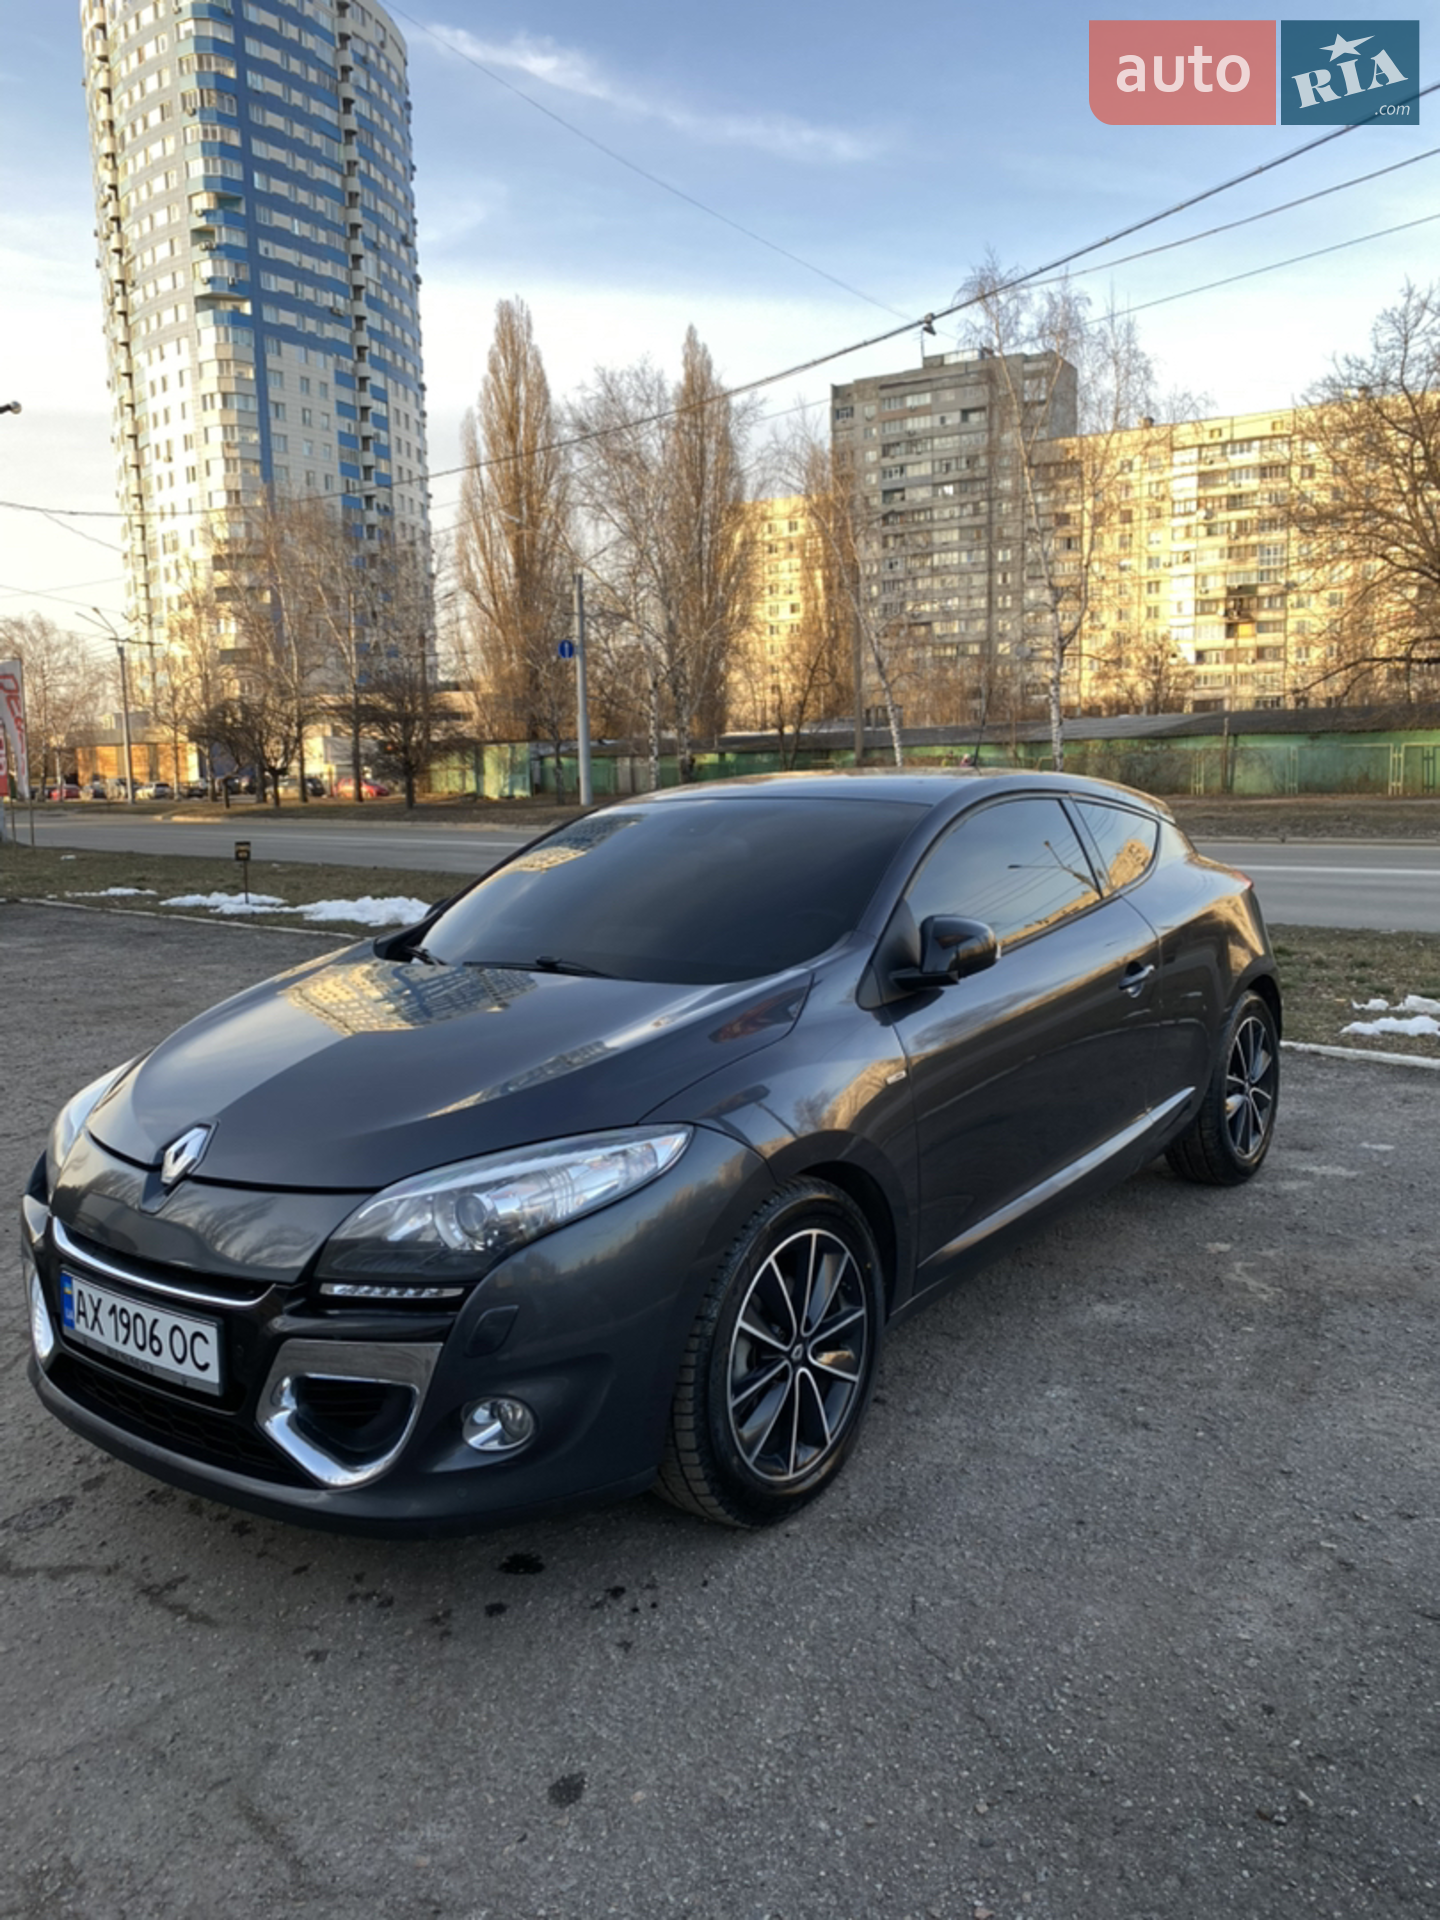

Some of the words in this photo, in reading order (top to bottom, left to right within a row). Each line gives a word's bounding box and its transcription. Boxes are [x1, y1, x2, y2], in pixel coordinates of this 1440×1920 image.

[76, 1289, 104, 1337] AX
[108, 1303, 163, 1358] 1906
[169, 1324, 211, 1372] OC
